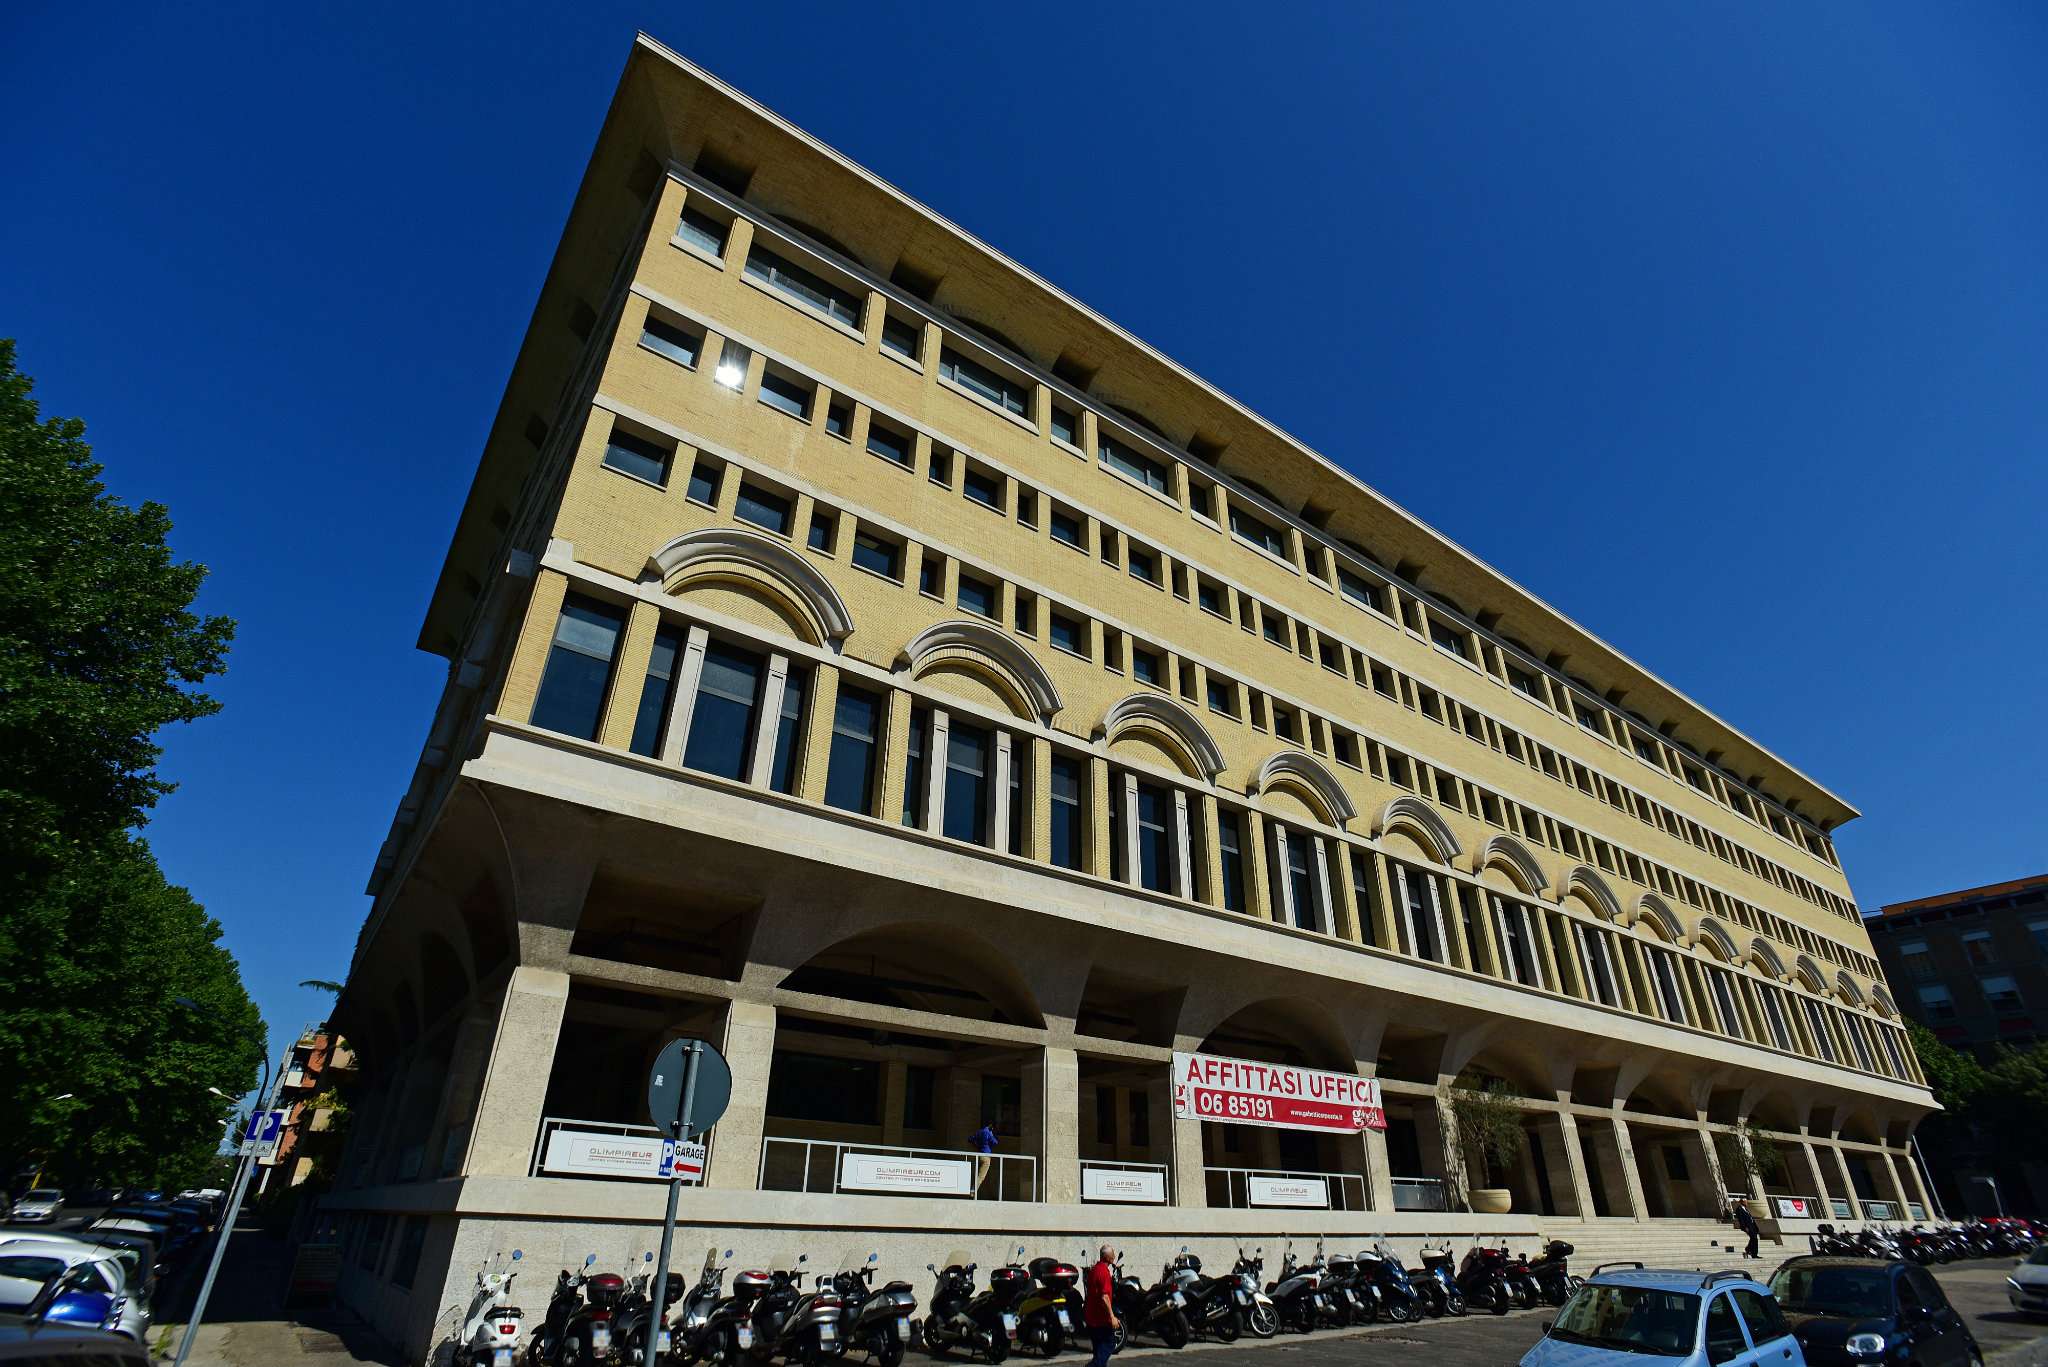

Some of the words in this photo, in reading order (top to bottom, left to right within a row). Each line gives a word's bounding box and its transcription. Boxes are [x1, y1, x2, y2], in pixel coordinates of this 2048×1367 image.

[1187, 1057, 1302, 1095] AFFITTASI
[1309, 1074, 1374, 1104] UFFICI
[1200, 1092, 1223, 1114] 06
[1228, 1095, 1273, 1119] 85191
[253, 1115, 274, 1136] P
[661, 1142, 674, 1166] P
[675, 1145, 704, 1160] GARAGE
